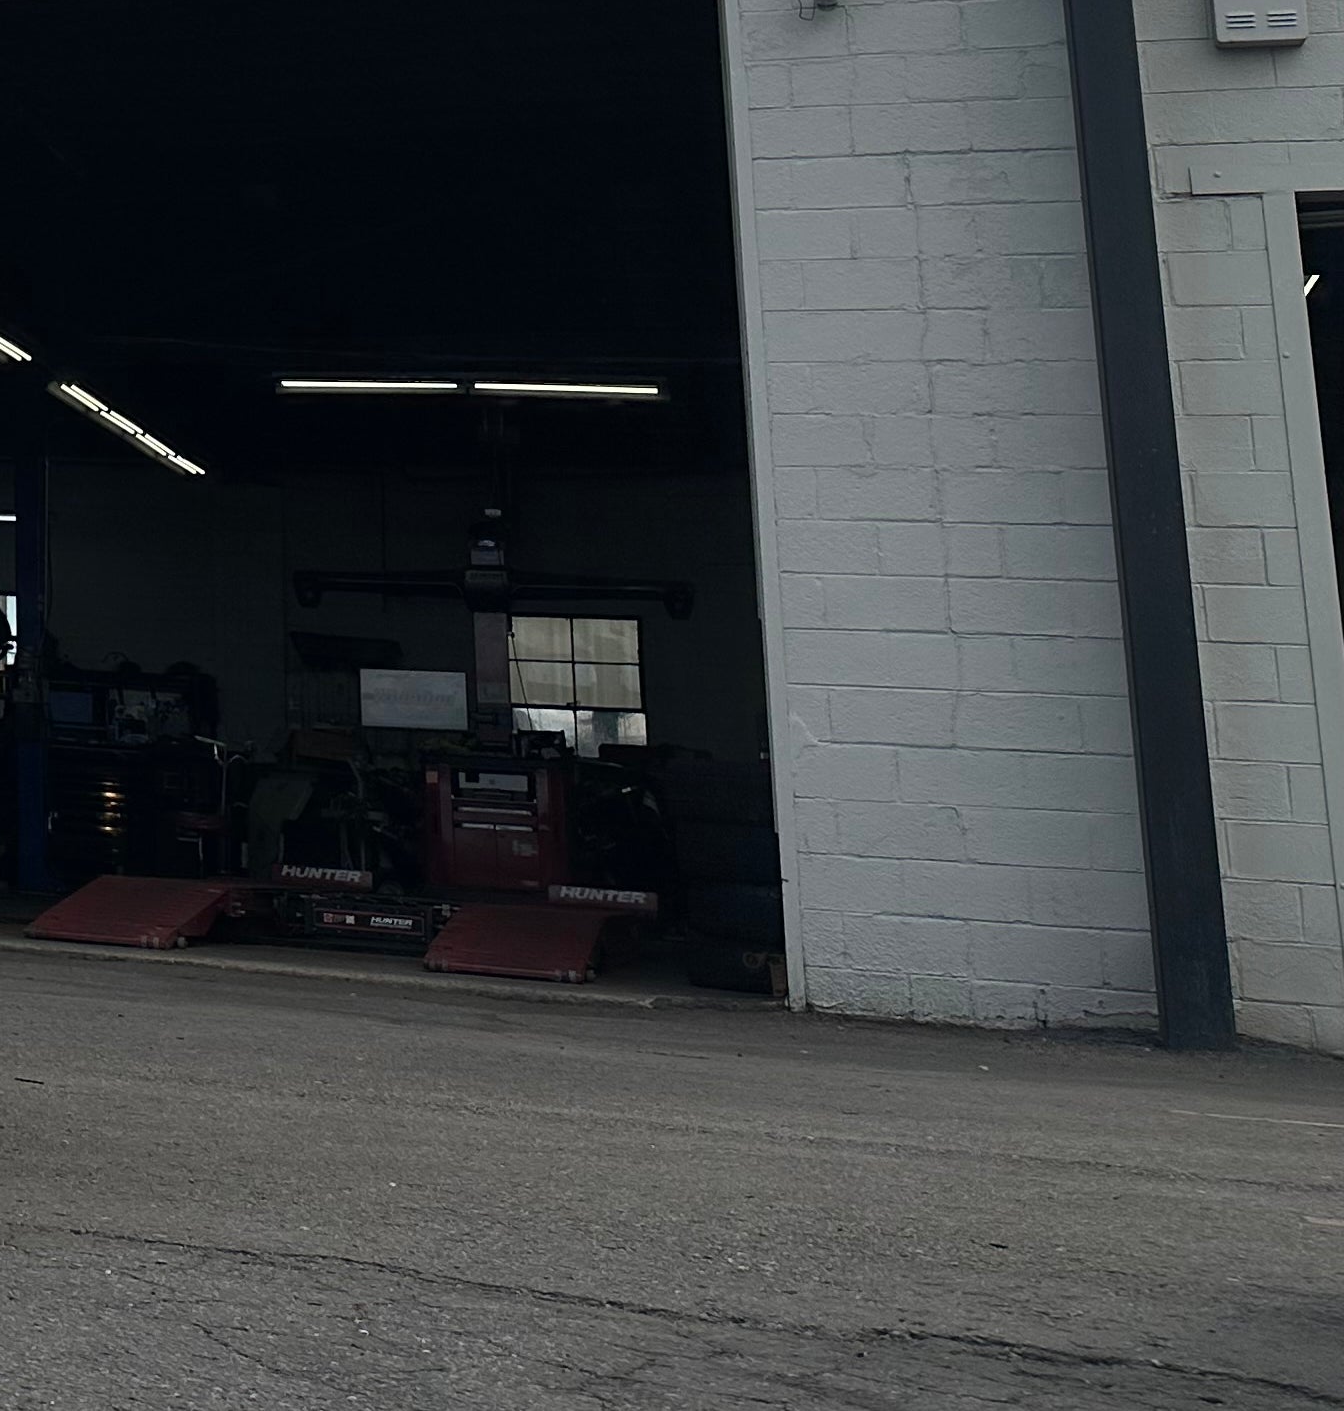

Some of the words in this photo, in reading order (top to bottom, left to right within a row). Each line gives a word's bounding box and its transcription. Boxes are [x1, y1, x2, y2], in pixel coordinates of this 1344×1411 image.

[280, 864, 362, 882] HUNTER
[558, 885, 648, 904] HUNTER
[369, 915, 414, 927] HUNTER
